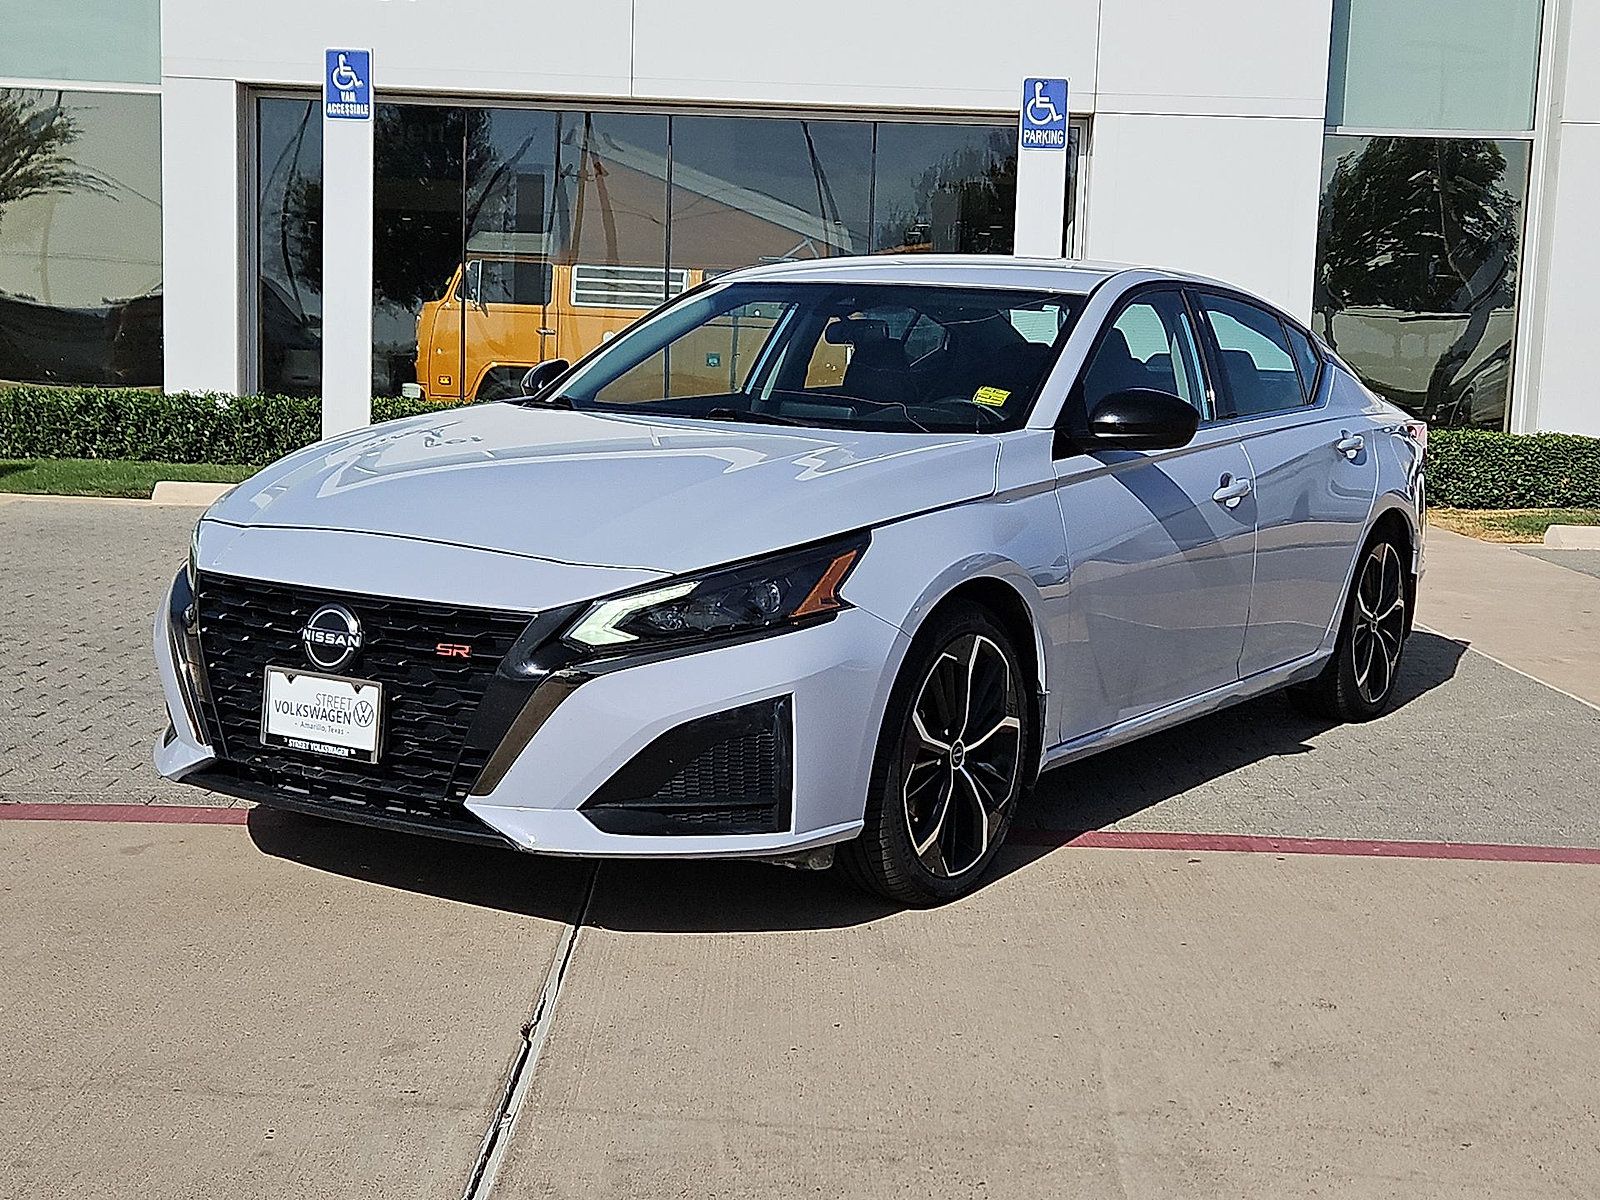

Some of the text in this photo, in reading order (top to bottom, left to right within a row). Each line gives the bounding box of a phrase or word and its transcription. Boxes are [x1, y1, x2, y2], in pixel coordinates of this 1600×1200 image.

[327, 103, 369, 115] ACCESSIBLE
[1024, 129, 1064, 145] PARKING
[302, 628, 361, 648] NISSAN
[436, 643, 472, 658] SR
[315, 692, 353, 711] STREET
[274, 699, 352, 726] VOLKSWAGEN
[288, 738, 310, 750] STREET
